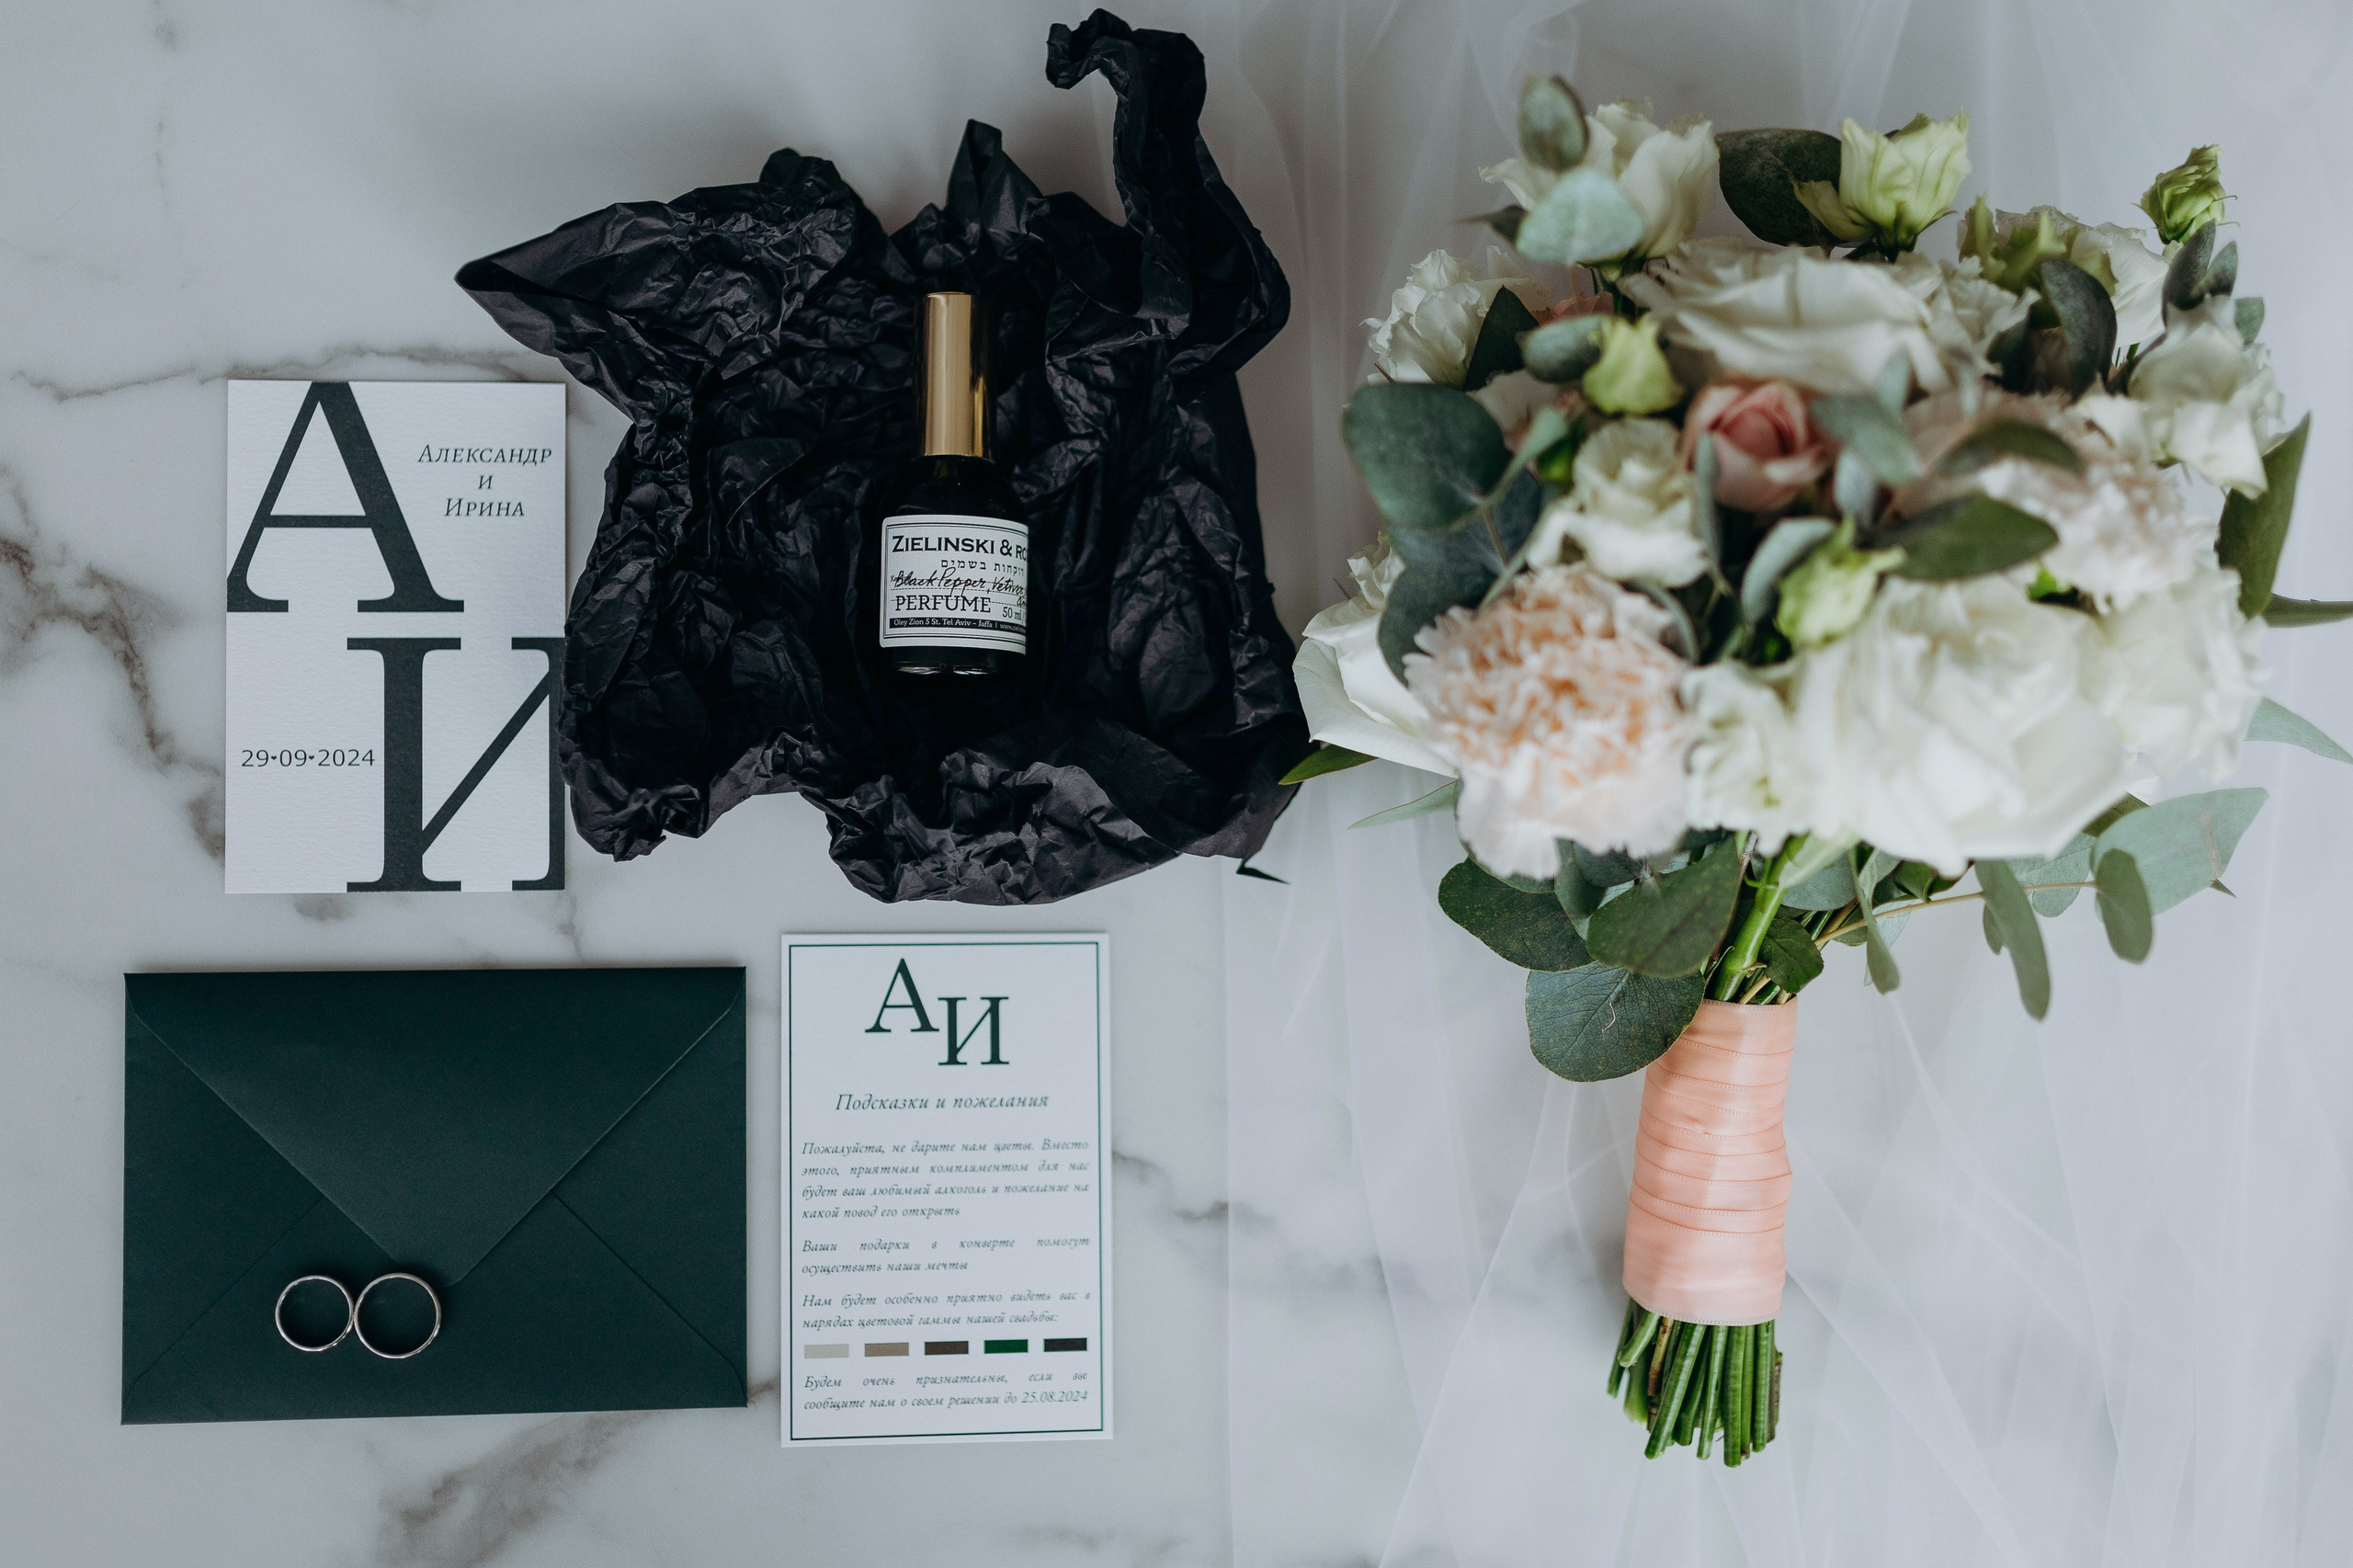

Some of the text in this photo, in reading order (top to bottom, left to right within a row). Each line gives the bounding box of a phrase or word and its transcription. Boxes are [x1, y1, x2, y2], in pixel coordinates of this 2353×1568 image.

[417, 444, 551, 466] Александр
[444, 497, 525, 517] Ирина
[1000, 540, 1012, 556] &
[941, 560, 986, 570] בשמים
[895, 596, 991, 613] PERFUME
[1002, 607, 1012, 618] 50
[835, 1094, 1049, 1110] Подсказки и пожелания
[801, 1138, 1088, 1157] Пожалуйста, не дарите нам цветы. Вместо
[801, 1159, 1087, 1179] этого, приятным комплиментом для нас
[802, 1183, 1088, 1200] будет ваш любимый алкоголь и пожелание на
[802, 1205, 960, 1221] какой повод его открыть
[801, 1237, 1089, 1254] Ваши подарки в конверте помогут
[801, 1261, 968, 1277] осуществить наши мечты
[801, 1294, 832, 1308] Нам
[841, 1293, 876, 1309] будет
[884, 1292, 938, 1305] особенно
[947, 1293, 1003, 1307] приятно
[1011, 1289, 1051, 1302] видеть
[1060, 1292, 1077, 1301] вас
[802, 1310, 1058, 1331] нарядах цветовой гаммы нашей свадьбы:
[804, 1372, 1086, 1392] Будем очень признательны, если вы
[804, 1390, 1088, 1411] сообщите нам о своем решении до 25.08.2024
